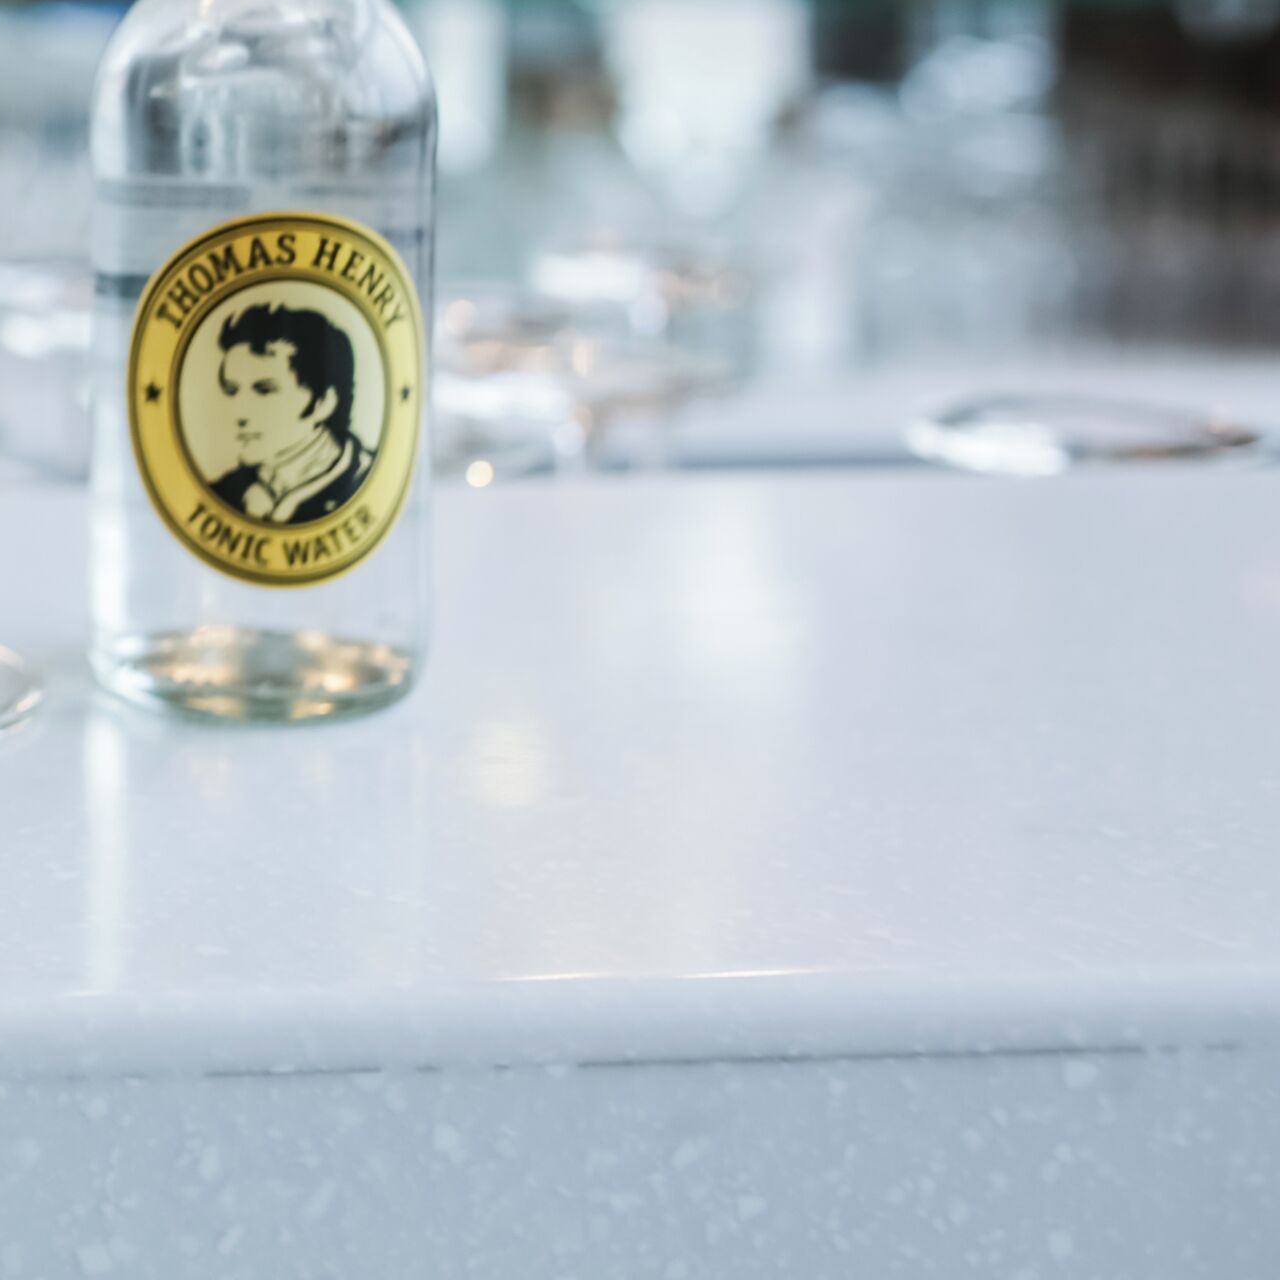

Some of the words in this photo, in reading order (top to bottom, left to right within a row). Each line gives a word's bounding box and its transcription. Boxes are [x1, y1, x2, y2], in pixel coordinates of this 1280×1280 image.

[156, 233, 297, 330] THOMAS
[312, 238, 408, 330] HENRY
[186, 503, 272, 565] TONIC
[282, 503, 375, 567] WATER
